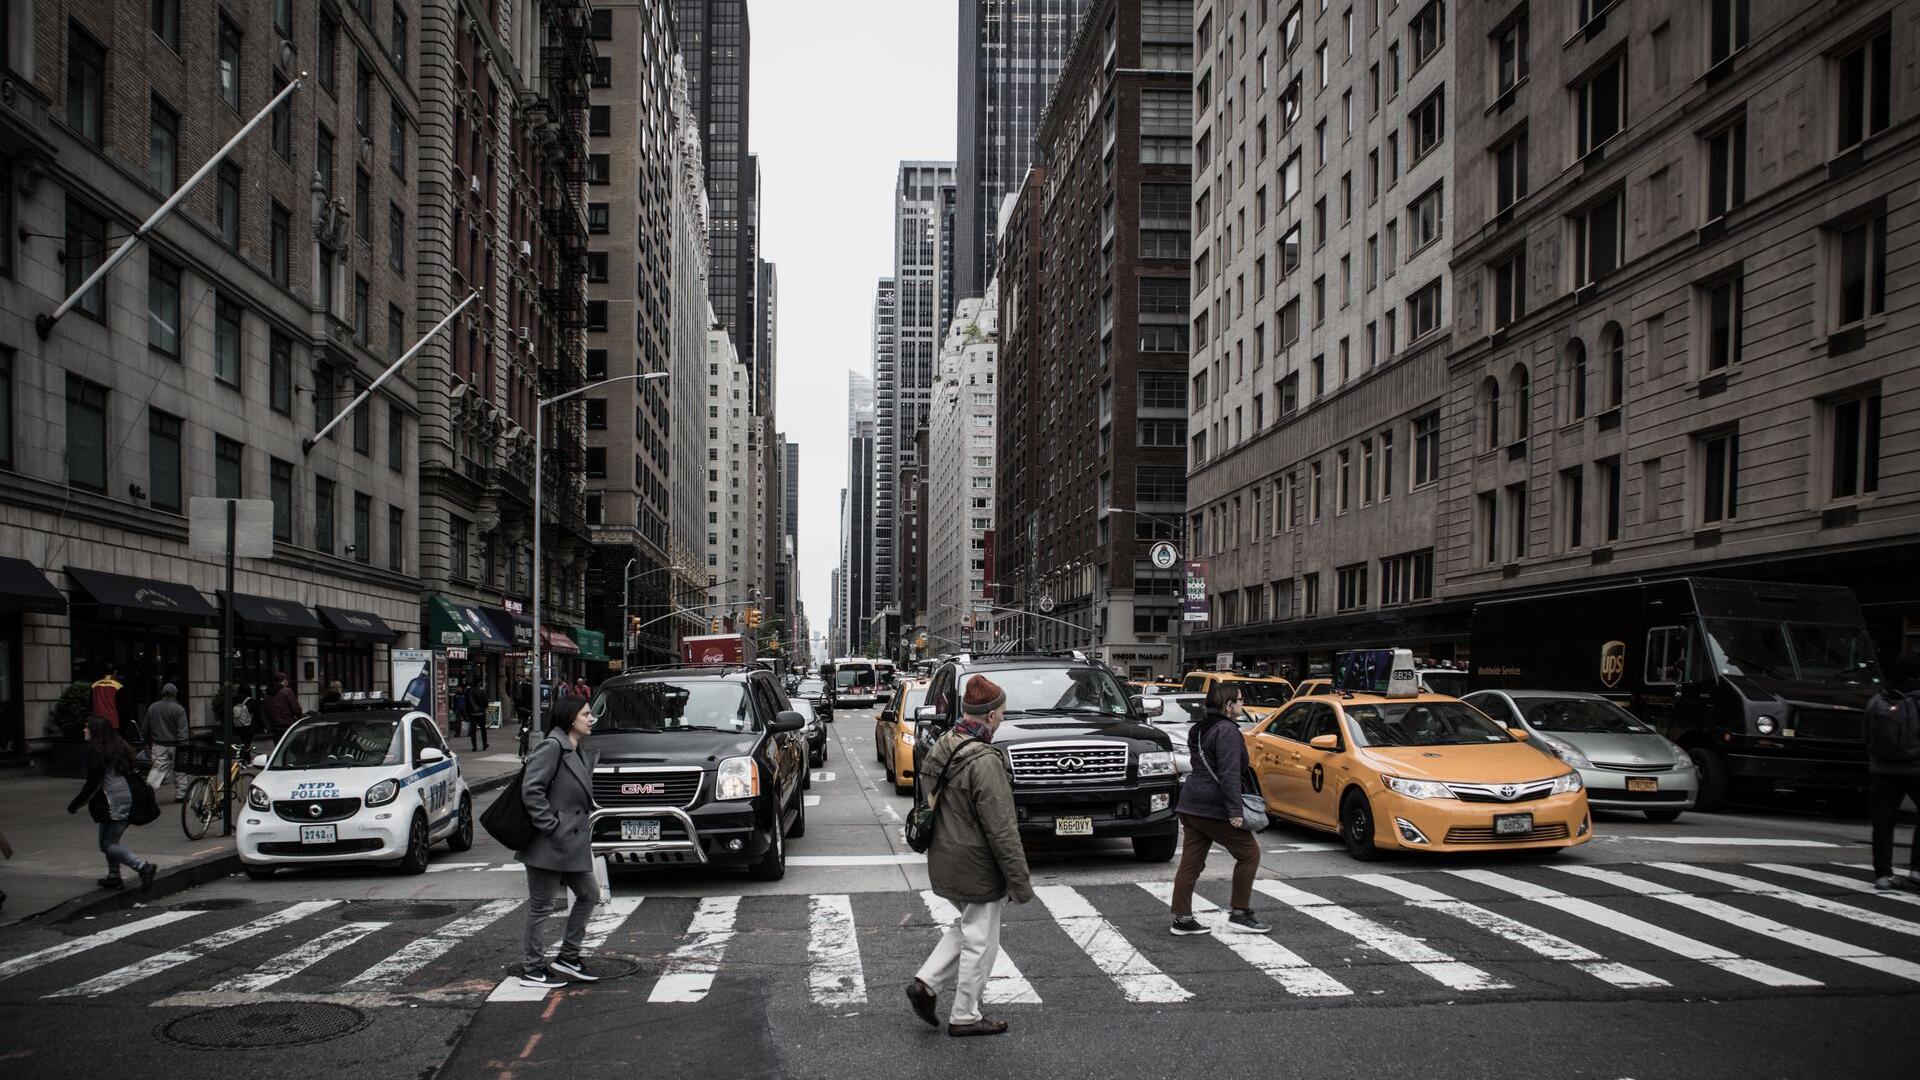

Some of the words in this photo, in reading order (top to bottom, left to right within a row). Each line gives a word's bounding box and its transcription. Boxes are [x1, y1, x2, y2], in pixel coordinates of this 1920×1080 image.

[448, 651, 466, 659] ATM
[1478, 666, 1502, 675] Worldwide
[1502, 666, 1521, 675] Services
[1602, 655, 1622, 681] ups
[1393, 670, 1413, 680] 6B25
[298, 782, 335, 790] NYPD
[621, 783, 665, 794] GMC
[290, 789, 340, 799] POLICE
[430, 780, 447, 812] NYPD
[304, 830, 326, 840] 2742
